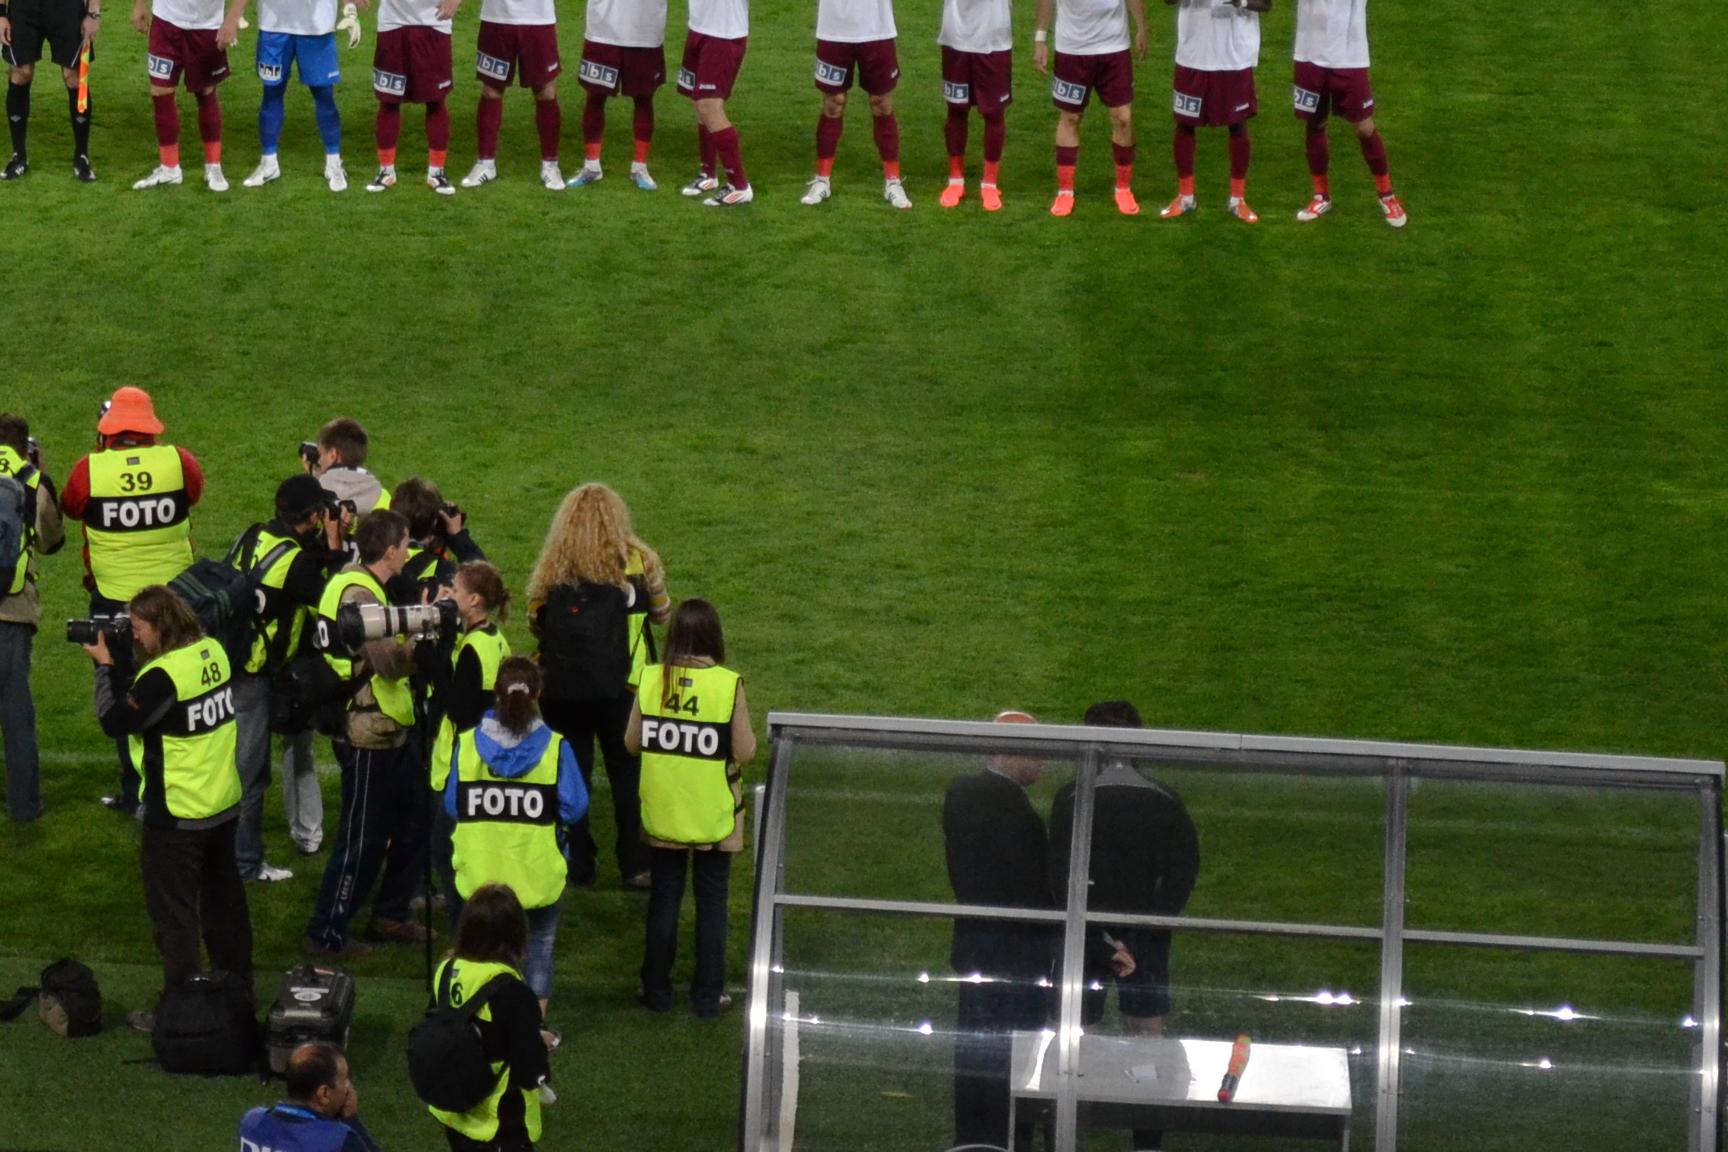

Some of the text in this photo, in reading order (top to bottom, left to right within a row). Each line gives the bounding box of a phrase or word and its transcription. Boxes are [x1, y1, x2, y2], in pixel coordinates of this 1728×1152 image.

[120, 471, 153, 492] 39
[102, 498, 176, 528] FOTO
[201, 661, 222, 687] 48
[663, 695, 699, 716] 44
[641, 720, 719, 756] FOTO
[467, 787, 544, 818] FOTO
